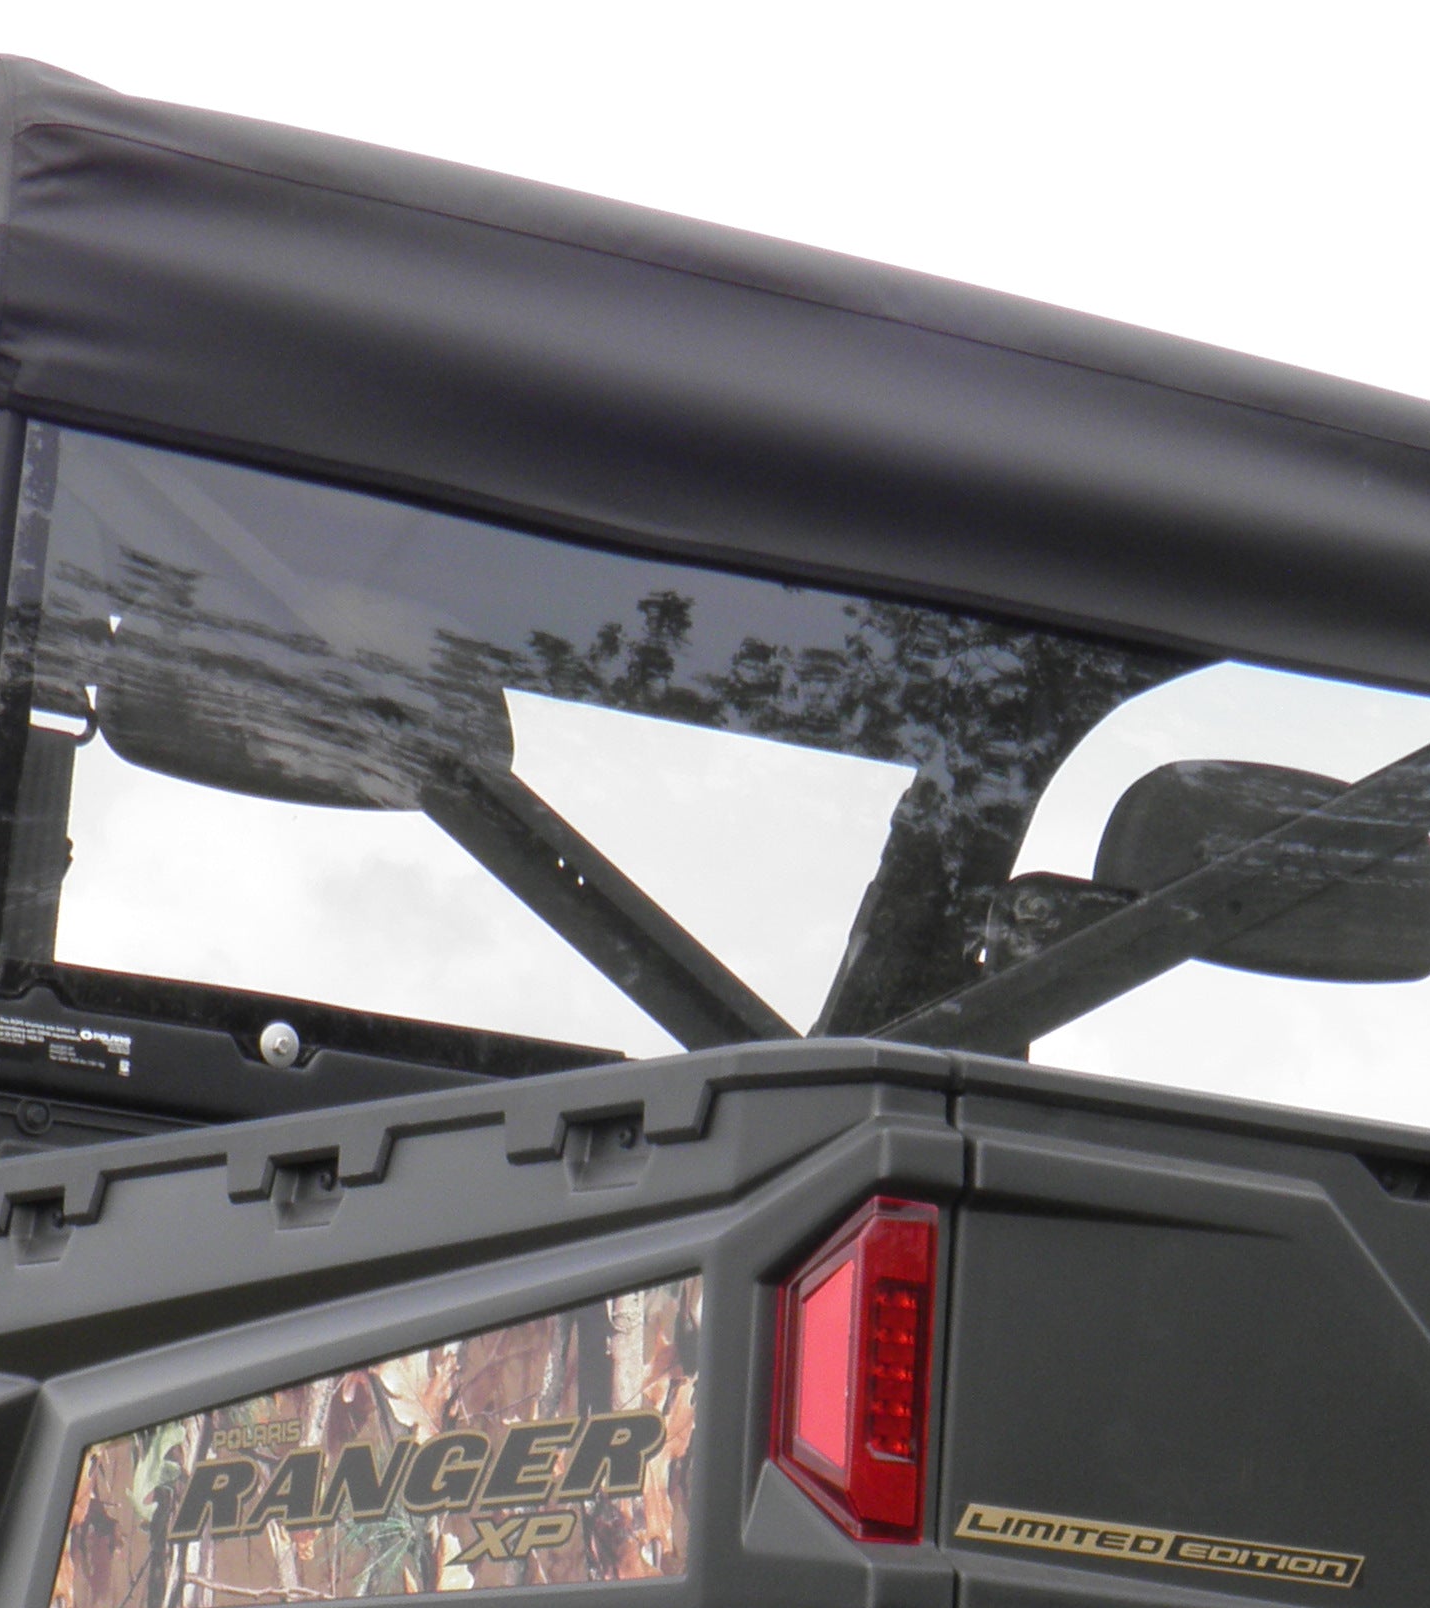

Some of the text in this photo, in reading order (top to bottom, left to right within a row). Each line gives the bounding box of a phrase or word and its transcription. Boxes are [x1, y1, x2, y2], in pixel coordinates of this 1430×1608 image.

[213, 1418, 301, 1452] POLARIS
[166, 1409, 668, 1543] RANGER
[447, 1511, 578, 1566] XP
[966, 1512, 1351, 1579] LIMITED EDITION
